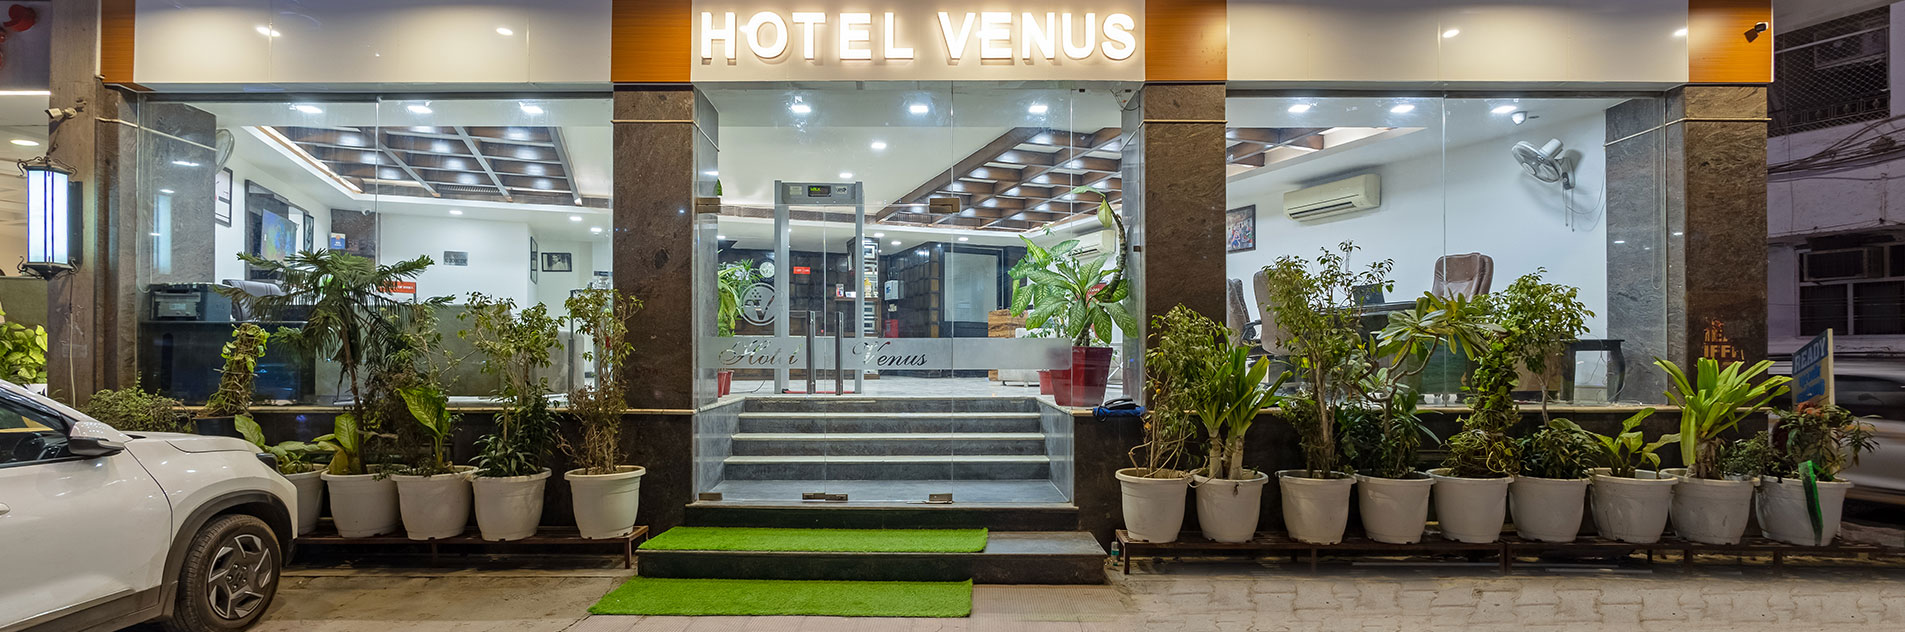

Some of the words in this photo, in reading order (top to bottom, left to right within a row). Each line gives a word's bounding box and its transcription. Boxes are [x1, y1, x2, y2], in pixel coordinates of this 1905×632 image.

[700, 11, 914, 60] HOTEL
[937, 11, 1137, 60] VENUS
[852, 341, 927, 366] Venus
[1793, 337, 1826, 374] READY
